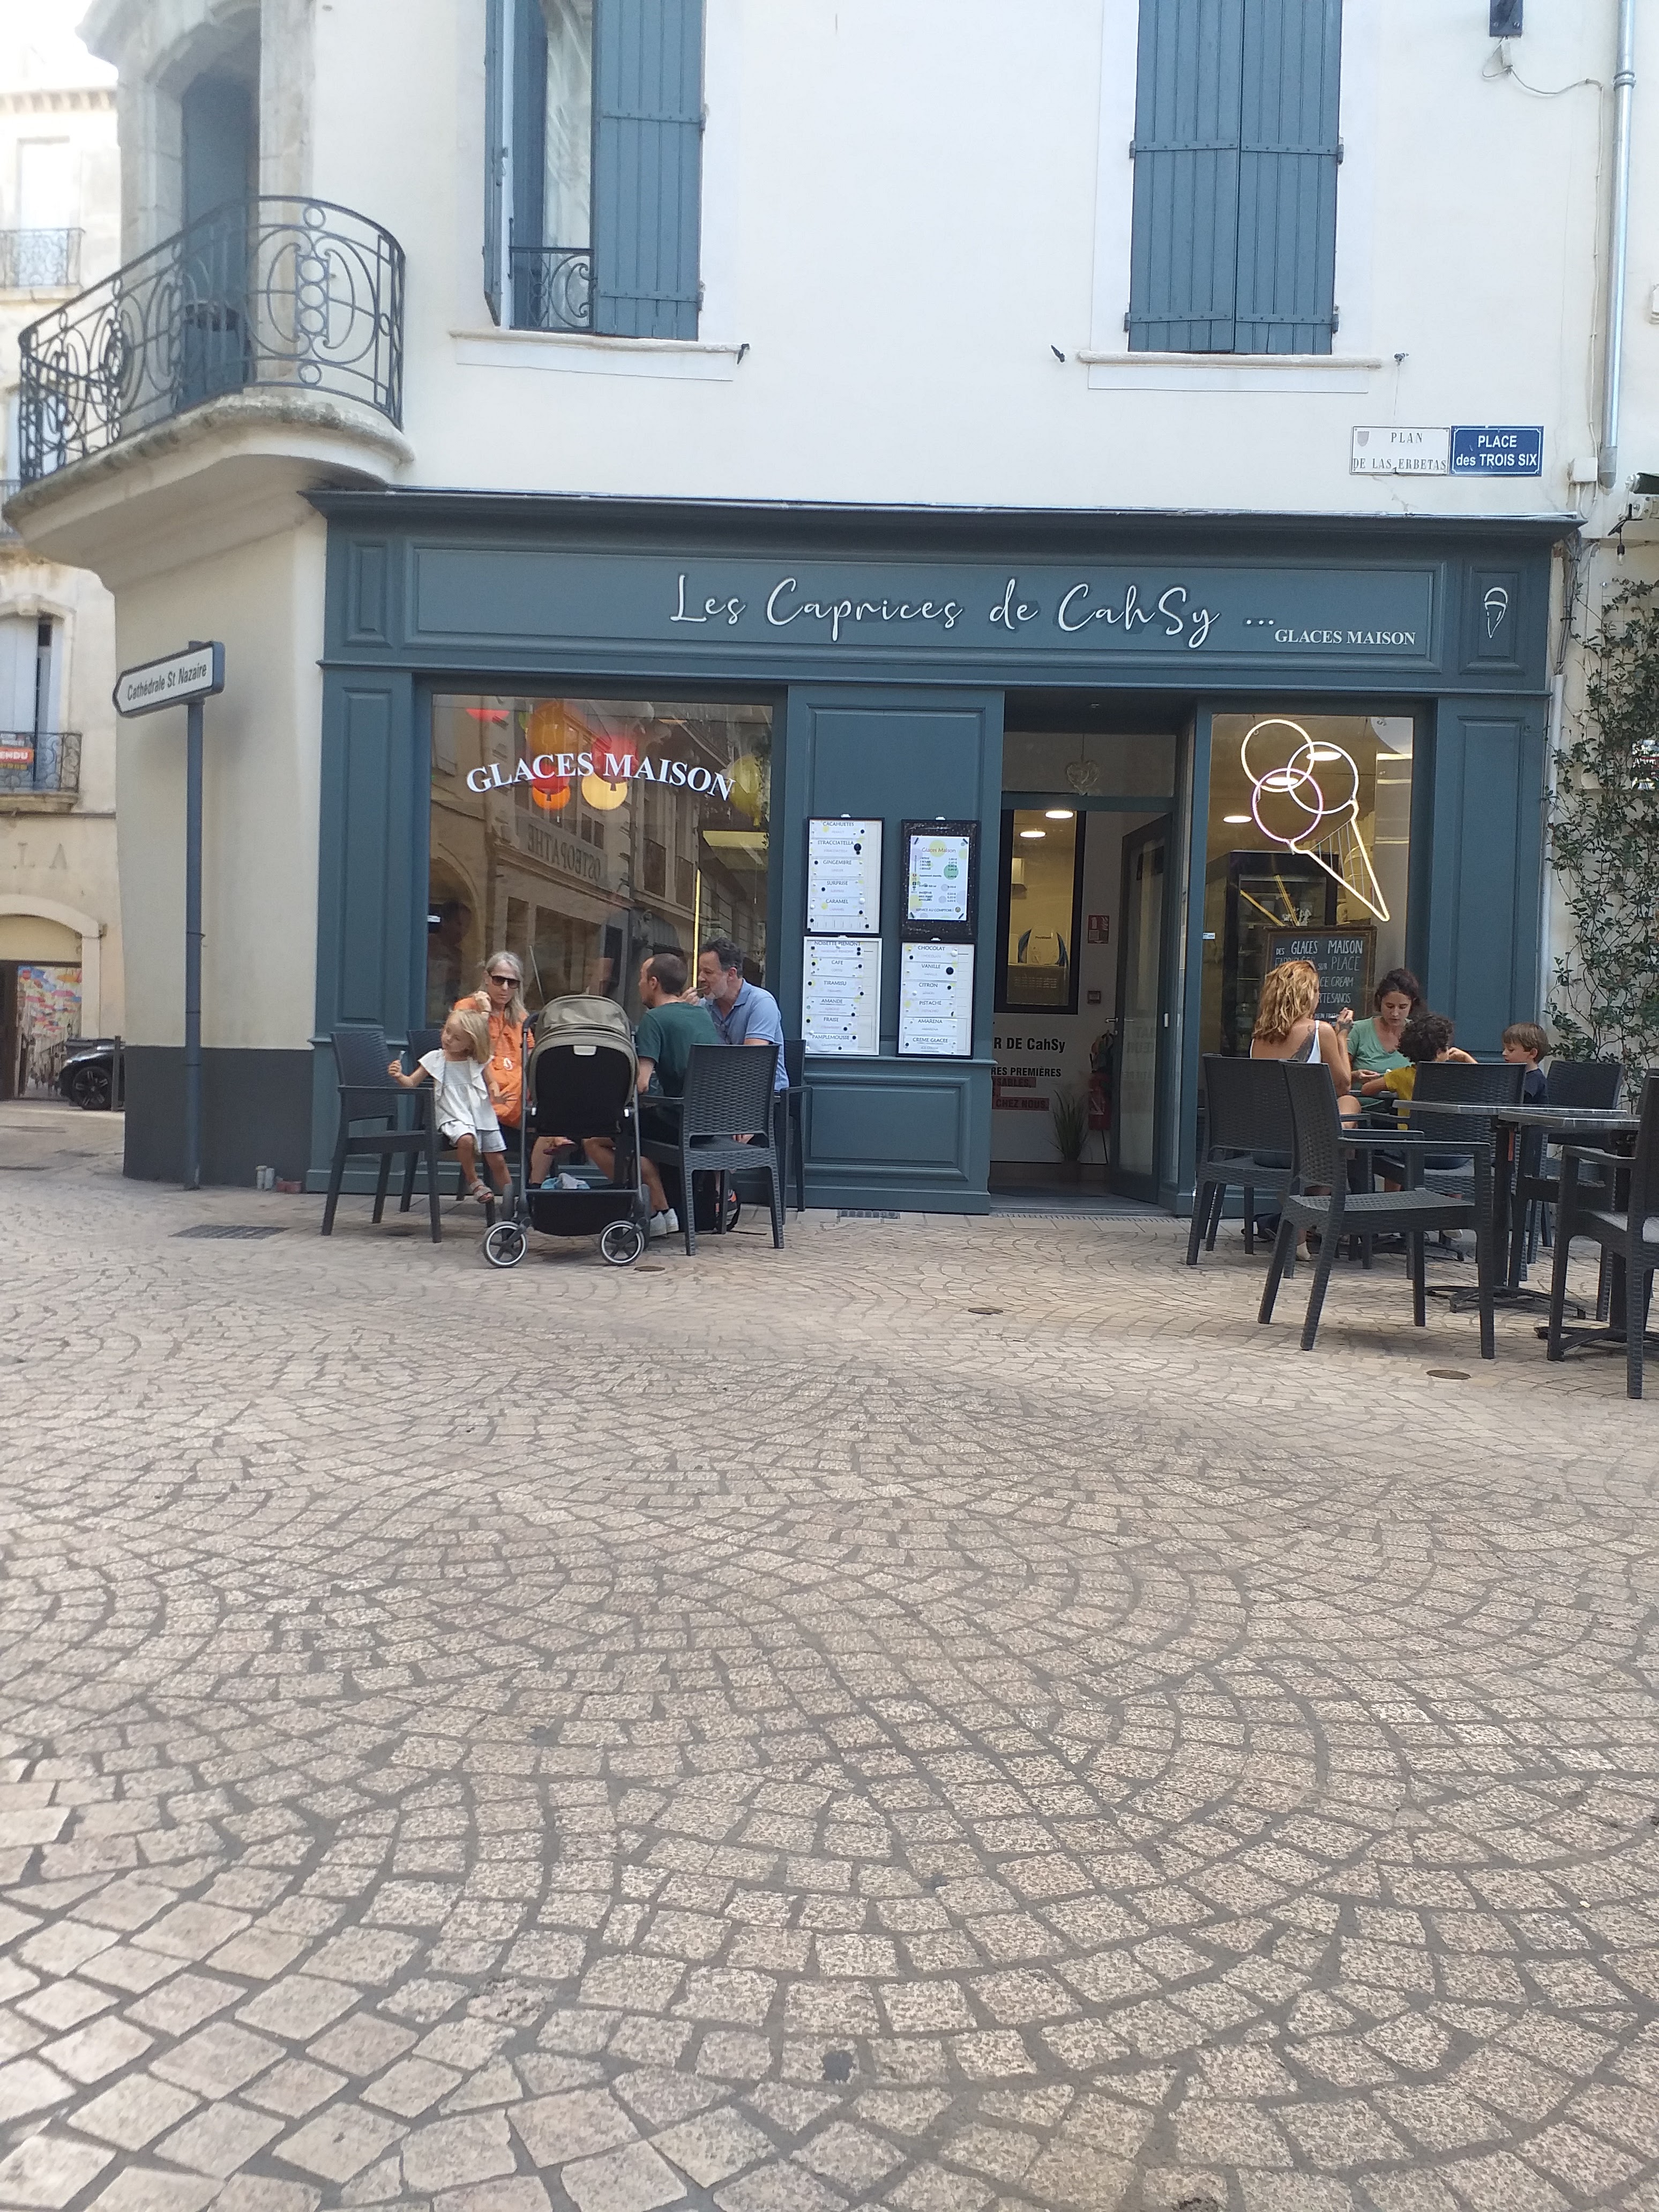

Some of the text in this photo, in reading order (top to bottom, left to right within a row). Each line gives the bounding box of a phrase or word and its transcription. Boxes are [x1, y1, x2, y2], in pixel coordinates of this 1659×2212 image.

[1391, 432, 1423, 443] PLAN
[1478, 435, 1517, 448] PLACE
[1353, 458, 1446, 470] DE LAS ERBETAS
[1456, 453, 1537, 467] des TROIS SIX
[670, 574, 746, 625] Les
[767, 577, 963, 641] Caprices
[989, 578, 1038, 630] de
[1058, 583, 1221, 649] CahSy
[1275, 629, 1416, 645] GLACES MAISON
[127, 662, 207, 702] Cathédrale St Nazaire
[0, 751, 28, 760] ENDU
[466, 752, 736, 802] GLACES MAISON
[1276, 940, 1363, 955] DES GLACES MAISON
[1318, 956, 1361, 972] SUR PLACE
[1331, 976, 1354, 987] CREAM
[1318, 992, 1351, 1004] RTESANOS
[994, 1037, 1065, 1053] R DE CahSy
[991, 1066, 1062, 1077] RES PREMIÈRES
[994, 1077, 1032, 1089] SABLES,
[996, 1098, 1019, 1108] CHEZ
